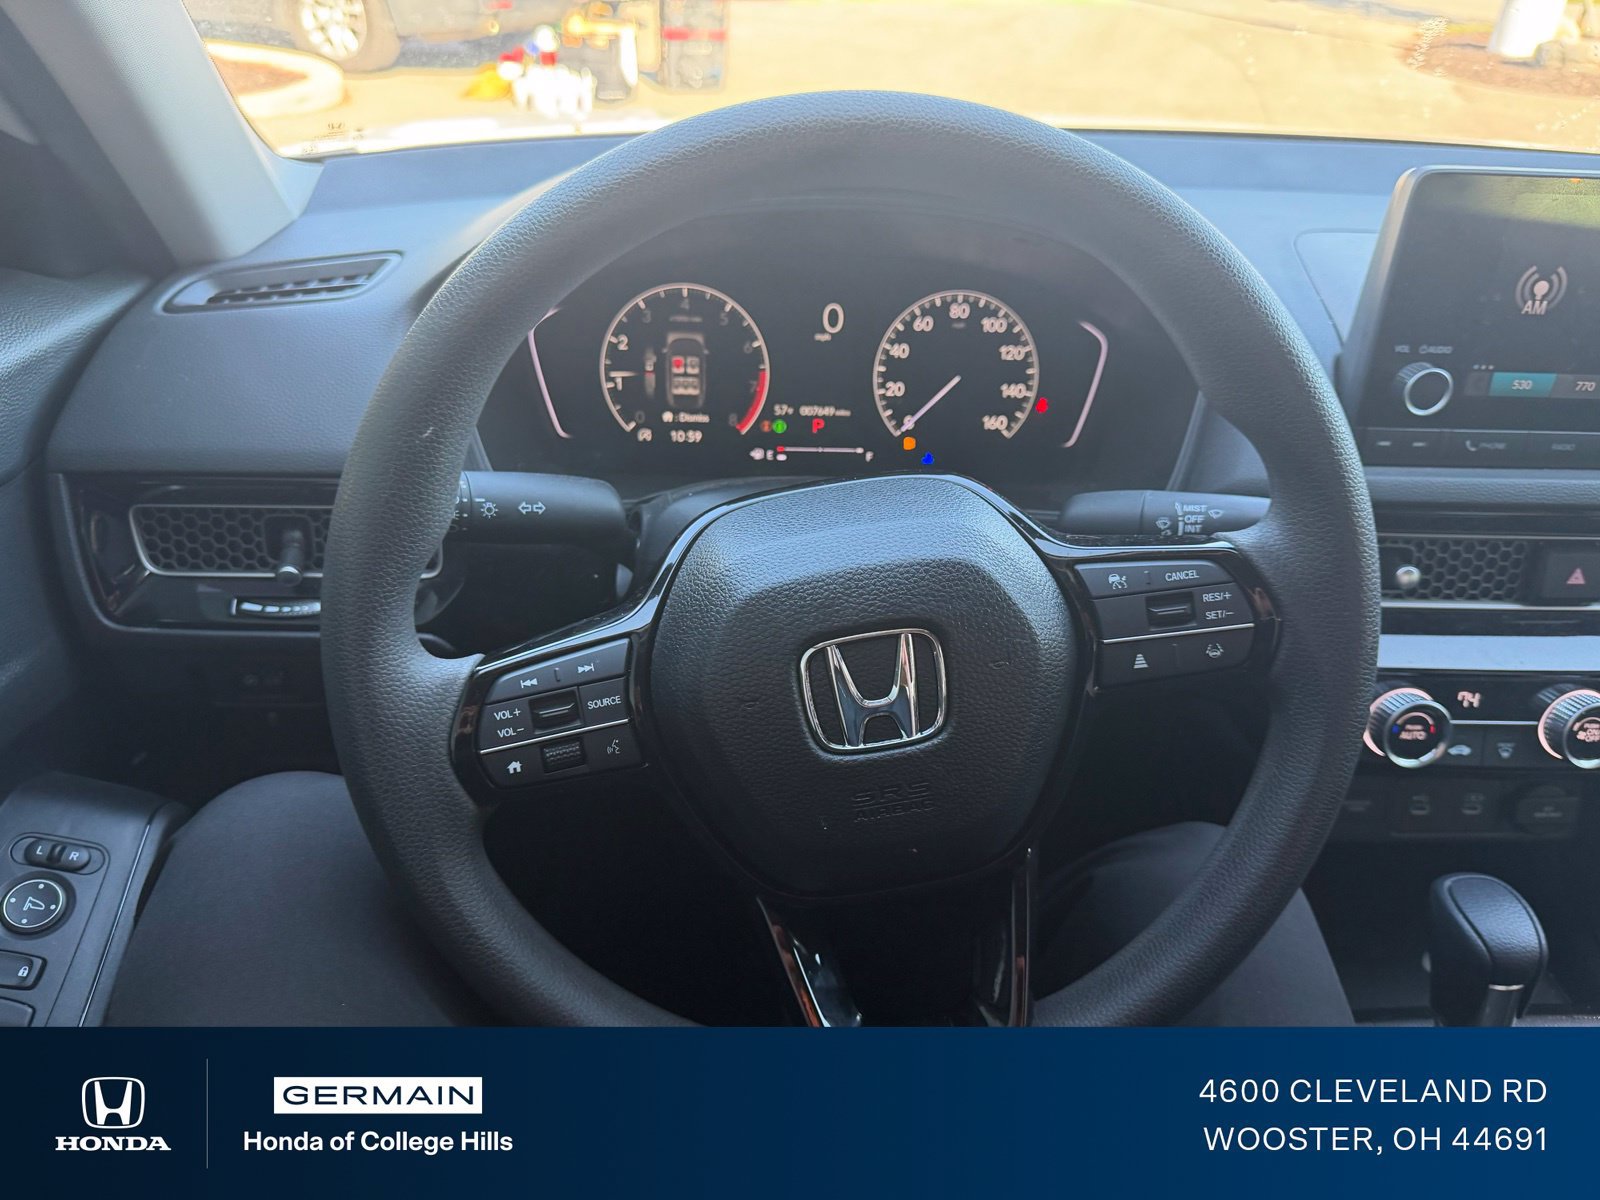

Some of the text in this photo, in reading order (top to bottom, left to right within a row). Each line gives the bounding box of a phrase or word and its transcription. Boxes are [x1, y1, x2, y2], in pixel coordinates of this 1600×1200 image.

[949, 303, 970, 319] 80
[1521, 300, 1548, 316] AM
[822, 302, 845, 333] 0
[913, 315, 934, 332] 60
[981, 317, 1008, 333] 100
[617, 334, 628, 351] 2
[889, 343, 910, 358] 40
[999, 345, 1025, 360] 120
[885, 381, 905, 397] 20
[1001, 383, 1027, 398] 140
[1511, 380, 1597, 391] 530 770
[811, 417, 825, 433] P
[982, 415, 1008, 430] 160
[1183, 504, 1207, 513] MIST
[1184, 514, 1205, 523] OFF
[1184, 524, 1203, 533] INT
[1165, 570, 1199, 582] CANCEL
[587, 695, 622, 710] SOURCE
[494, 708, 521, 721] VOL+
[36, 846, 43, 855] L
[68, 851, 80, 861] R
